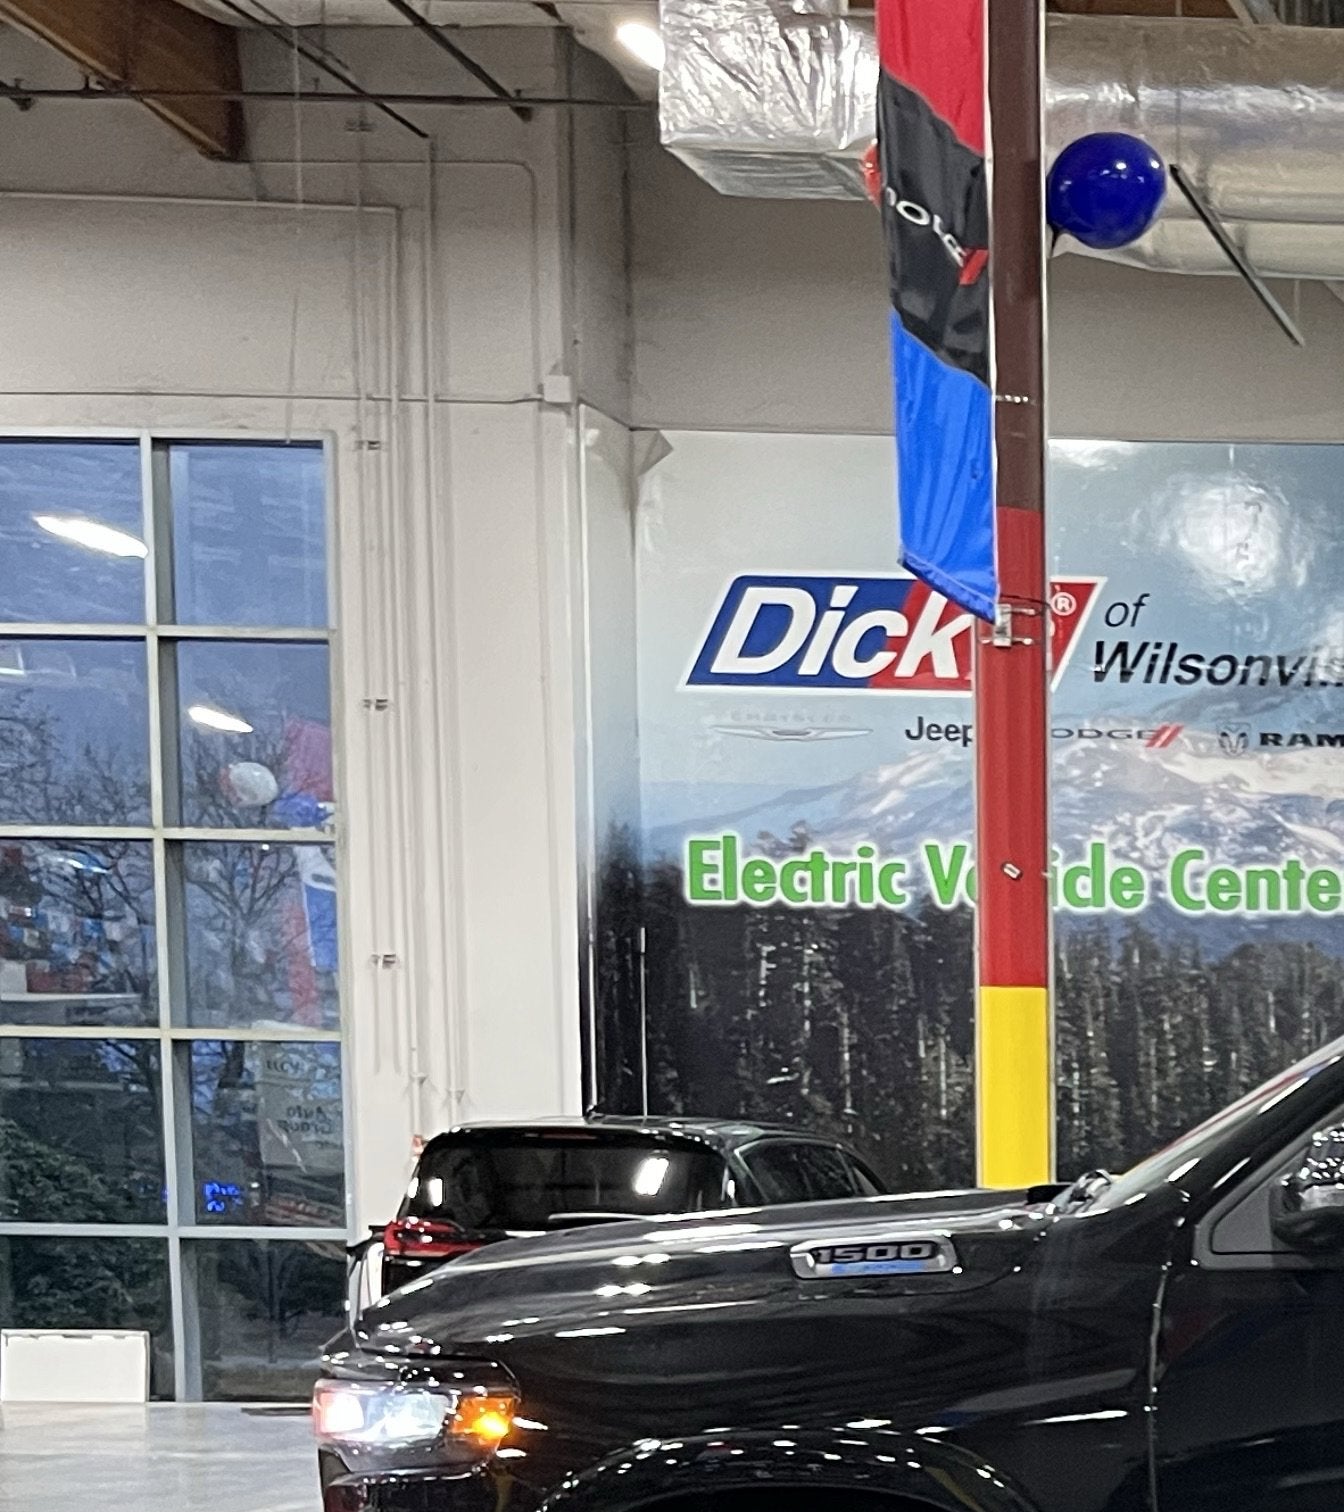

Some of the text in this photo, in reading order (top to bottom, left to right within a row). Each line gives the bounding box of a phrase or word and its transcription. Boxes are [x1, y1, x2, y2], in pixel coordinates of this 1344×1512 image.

[1104, 593, 1150, 628] of
[709, 585, 1056, 680] Dick
[1051, 728, 1158, 740] ODGE
[689, 835, 907, 905] Electric
[924, 842, 1146, 909] Vicle
[814, 1243, 932, 1263] 1500
